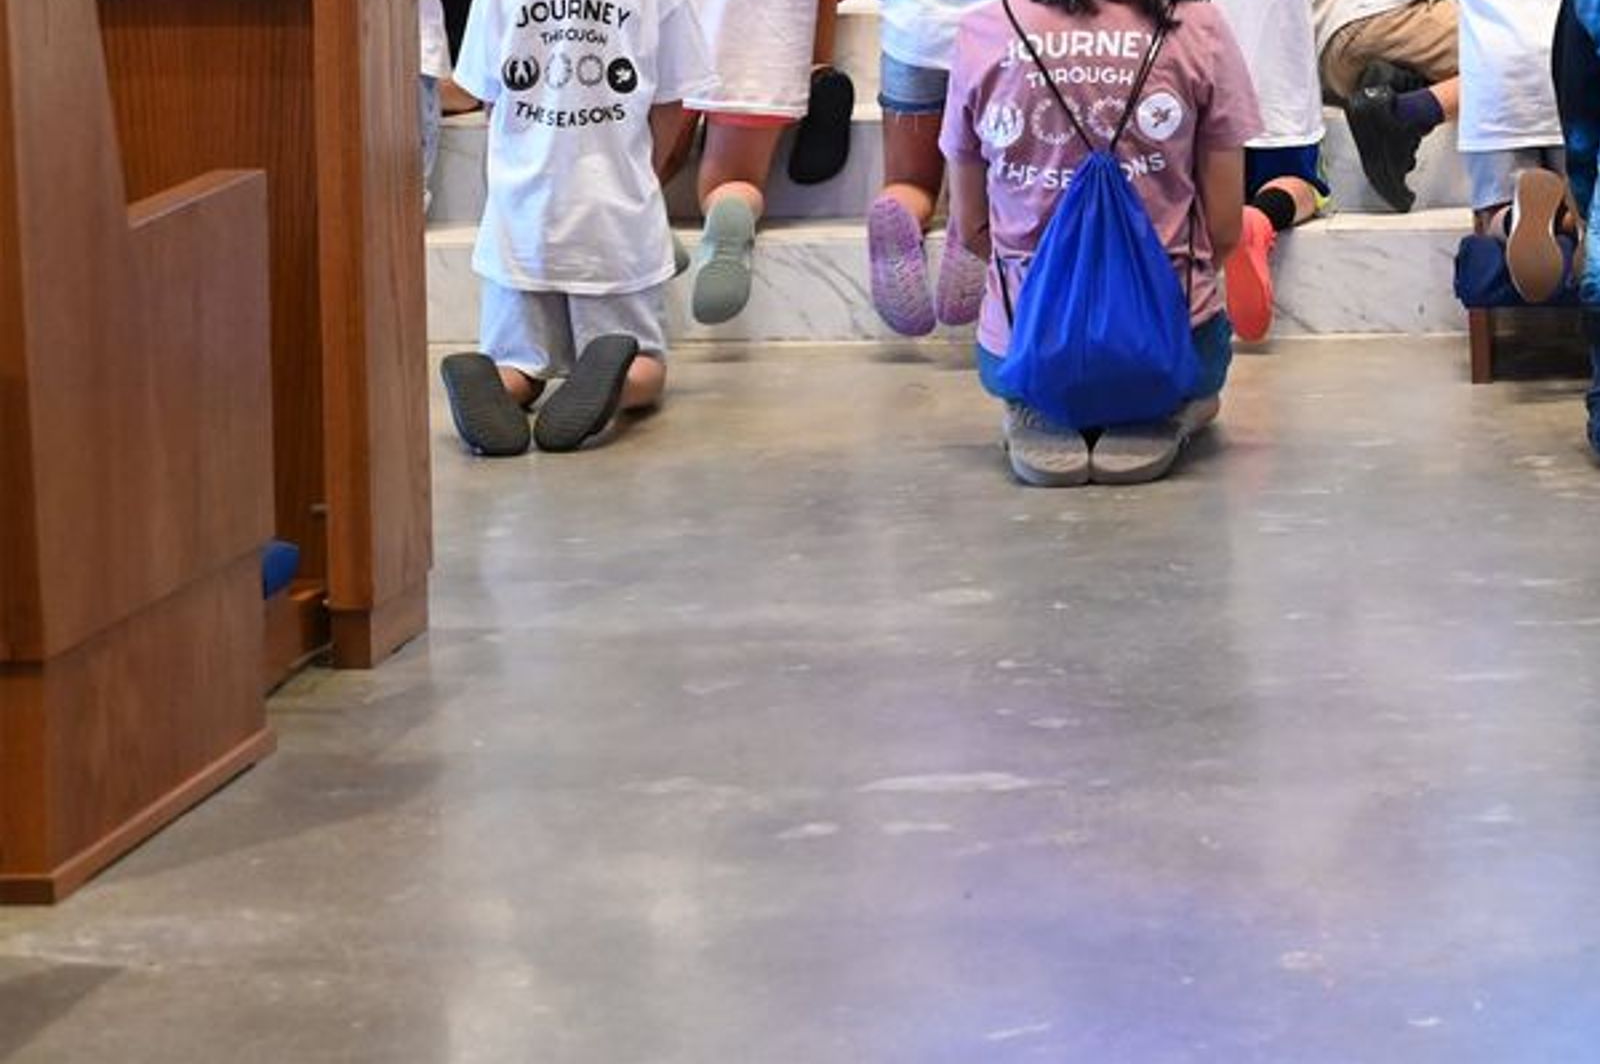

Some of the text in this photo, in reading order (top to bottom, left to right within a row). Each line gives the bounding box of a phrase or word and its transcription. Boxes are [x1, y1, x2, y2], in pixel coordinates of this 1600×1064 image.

[540, 28, 608, 45] THROUGH
[515, 101, 625, 127] THE SEASONS
